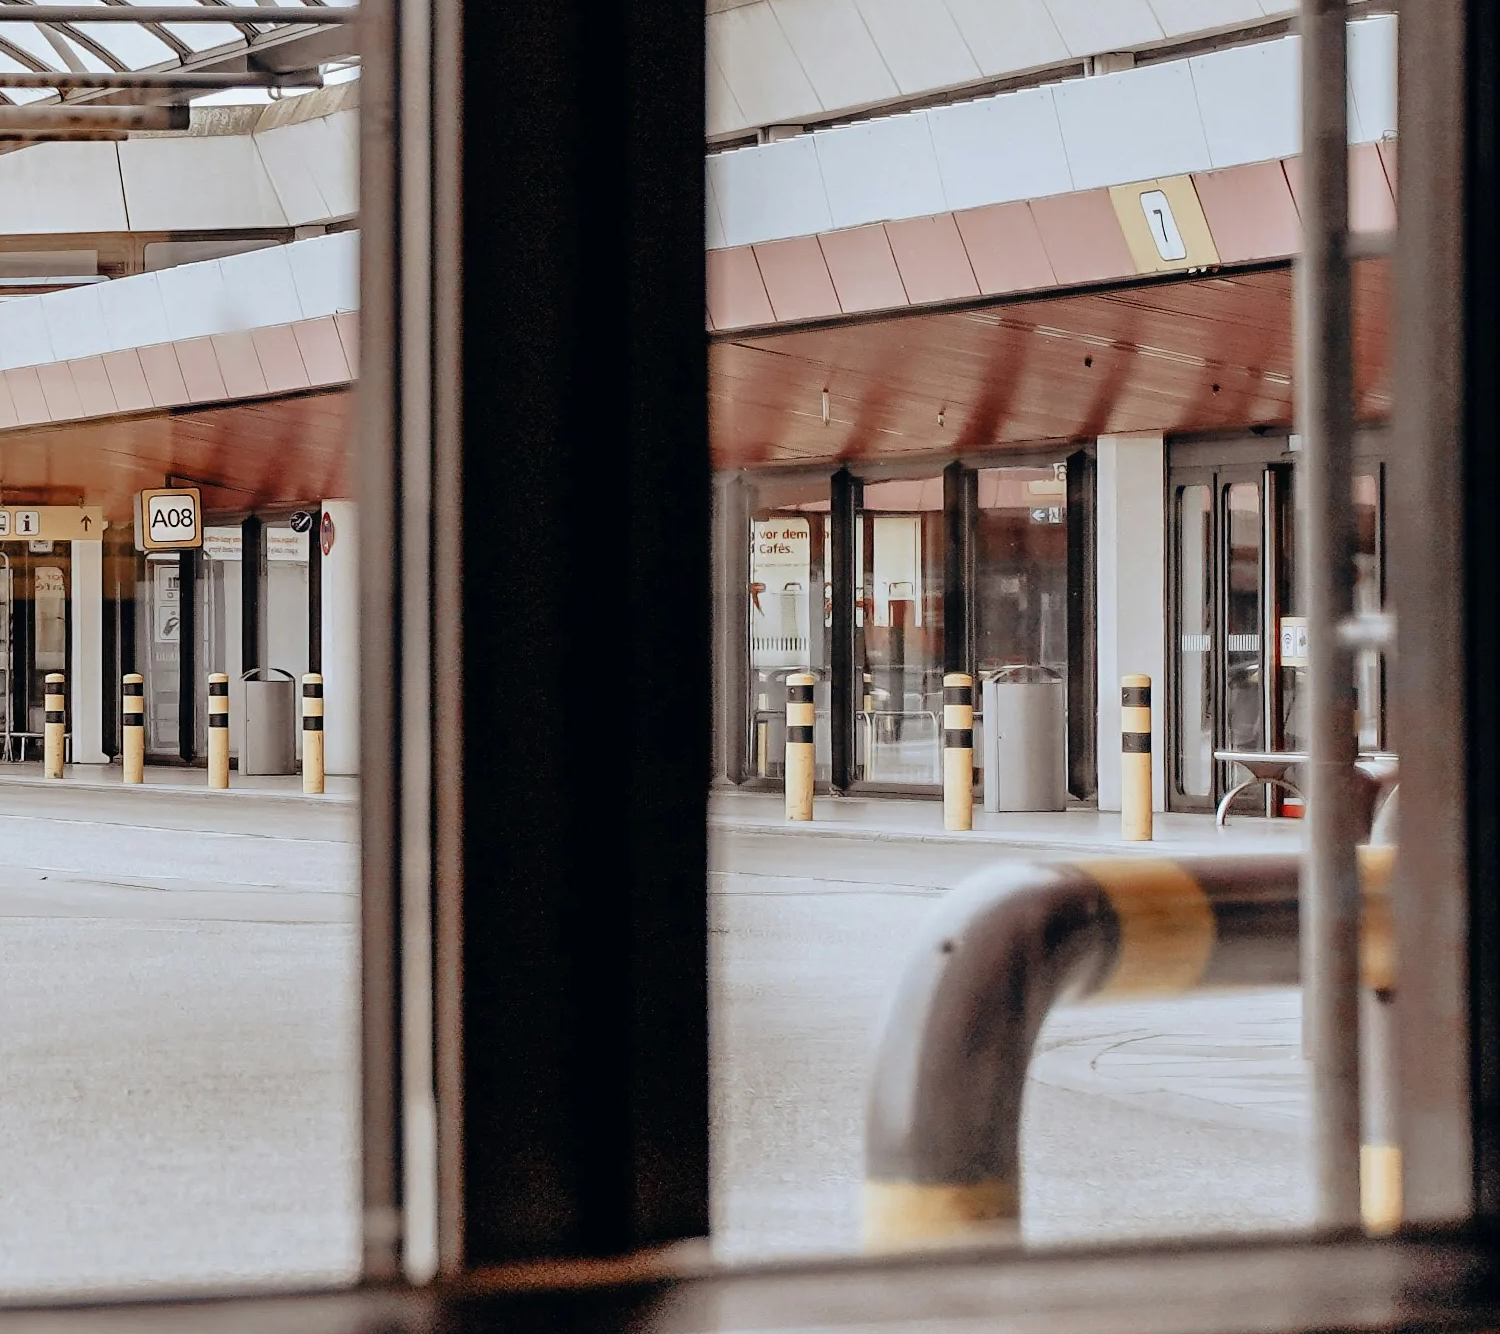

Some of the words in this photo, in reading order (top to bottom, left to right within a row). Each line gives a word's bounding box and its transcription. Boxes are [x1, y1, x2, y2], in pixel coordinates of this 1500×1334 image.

[1153, 209, 1169, 243] 7
[151, 508, 194, 528] A08
[760, 531, 778, 540] vor
[782, 529, 807, 540] dem
